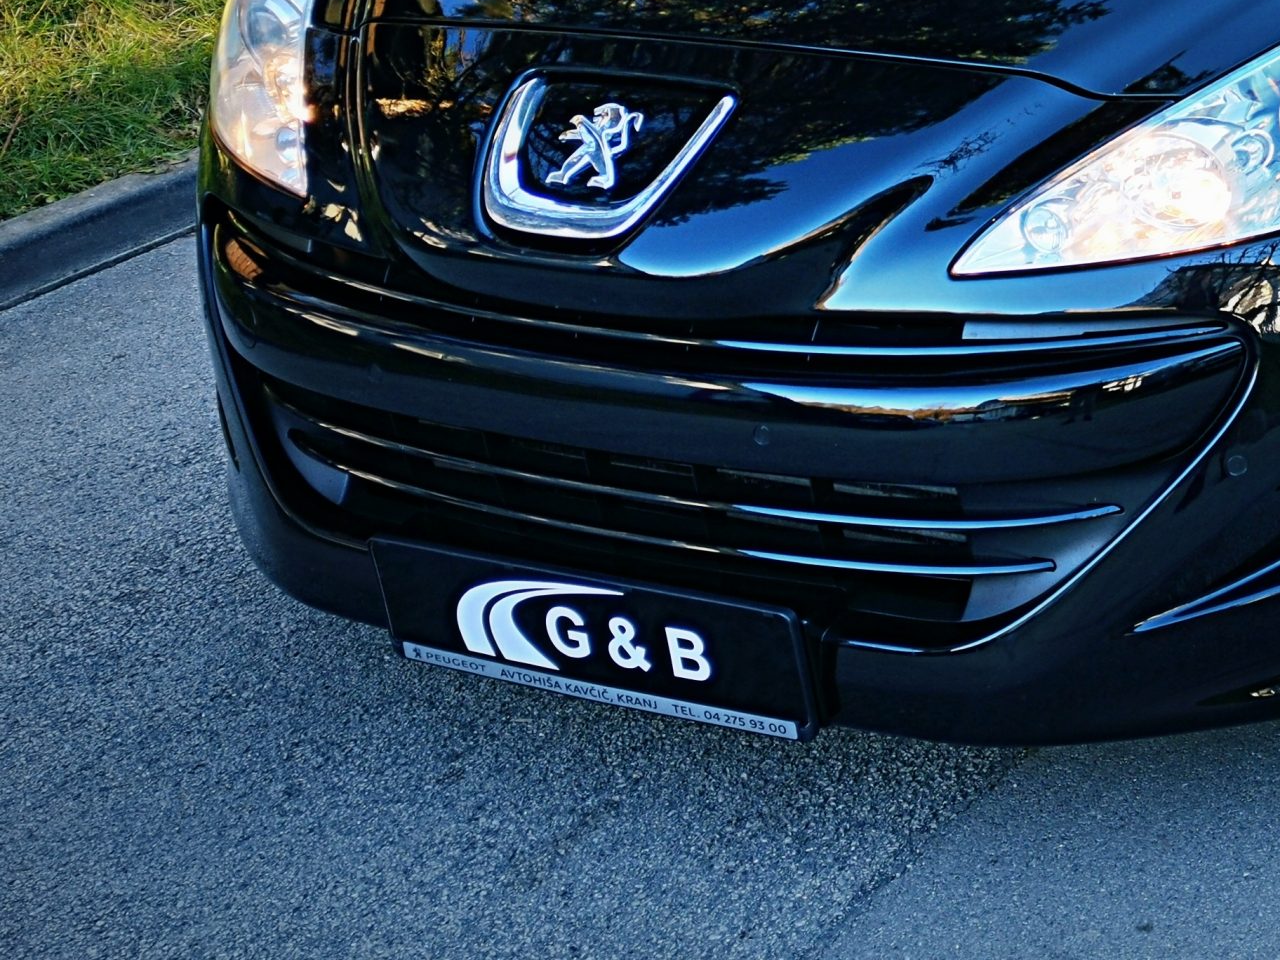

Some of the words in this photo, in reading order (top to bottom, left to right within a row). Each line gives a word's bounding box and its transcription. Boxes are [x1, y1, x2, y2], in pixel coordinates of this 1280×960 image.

[545, 605, 591, 659] G
[607, 616, 652, 672] &
[664, 626, 712, 682] B
[425, 651, 486, 672] PEUGEOT
[500, 668, 563, 690] AVTOHIŠA
[564, 682, 614, 703] KAVČIČ,
[616, 692, 658, 710] KRANJ
[671, 703, 701, 719] TEL.
[703, 710, 721, 721] 04
[724, 714, 746, 727] 275
[749, 719, 765, 730] 93
[768, 723, 787, 735] 00
